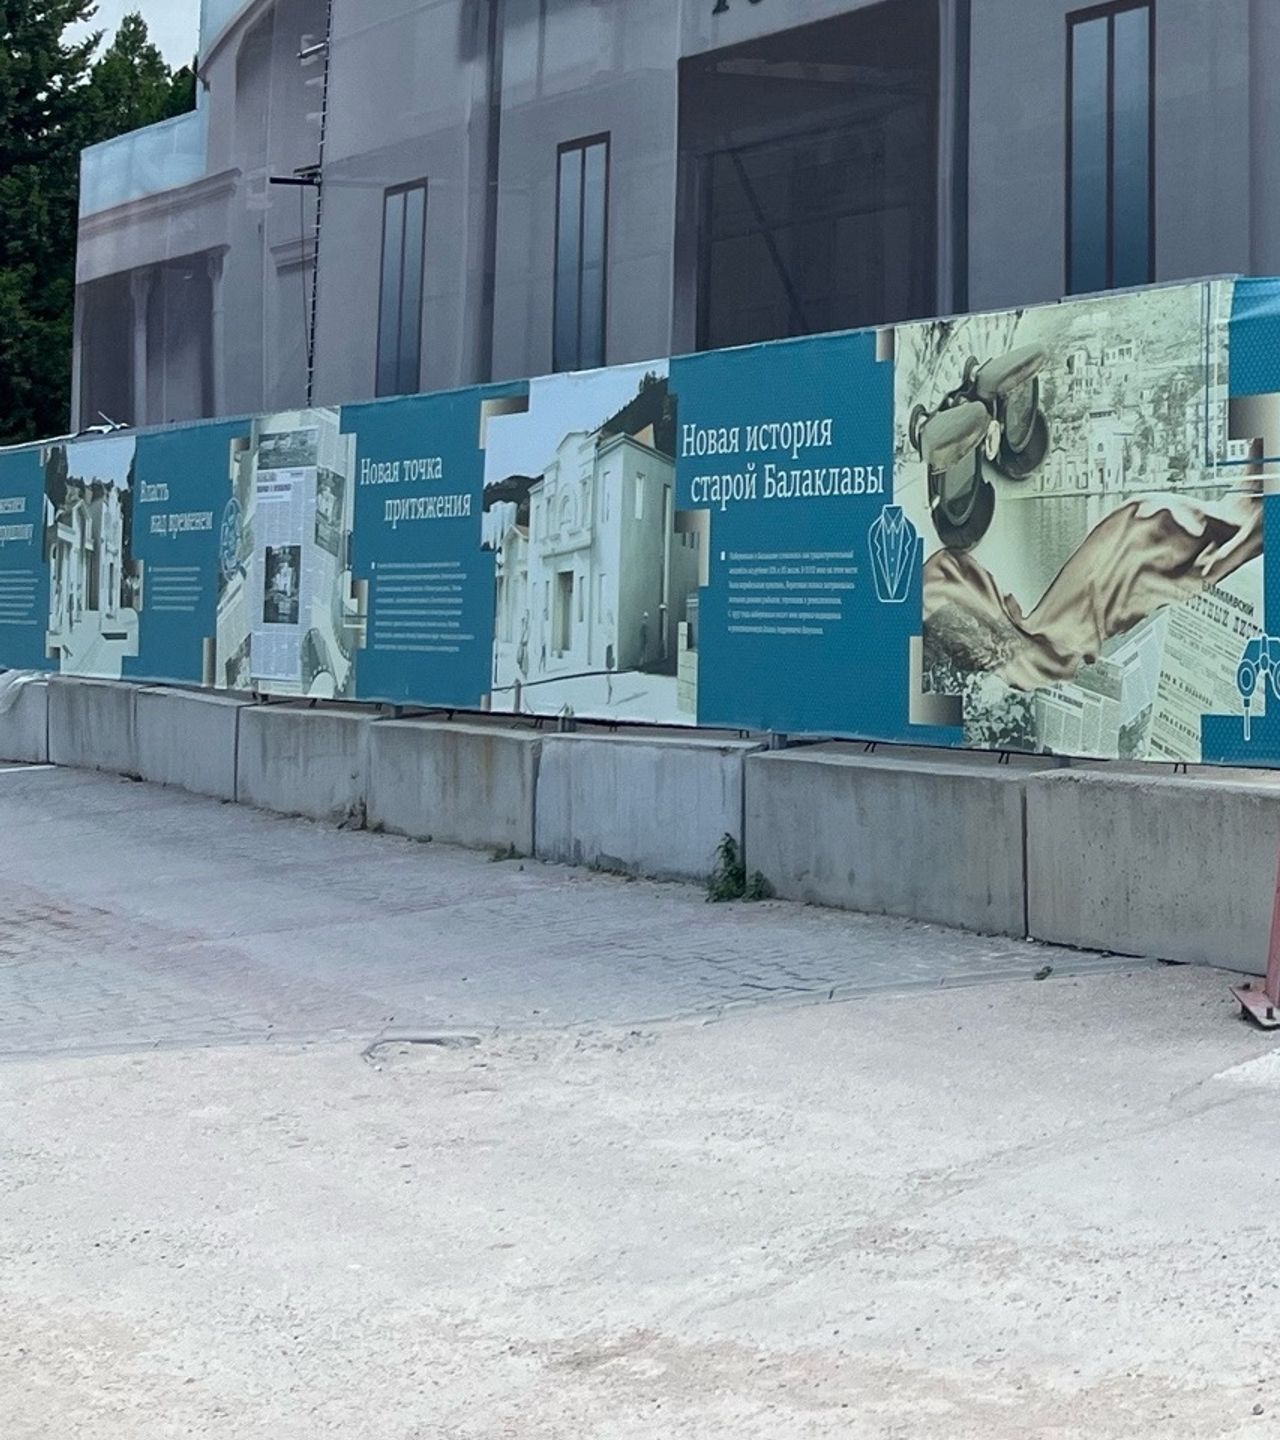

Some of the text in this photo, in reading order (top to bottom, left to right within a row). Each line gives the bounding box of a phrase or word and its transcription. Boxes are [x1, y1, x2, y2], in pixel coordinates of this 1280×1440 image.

[682, 418, 832, 459] Новая история
[361, 457, 443, 485] Новая точка
[691, 463, 885, 511] старой Балаклавы
[384, 494, 472, 529] притяжения
